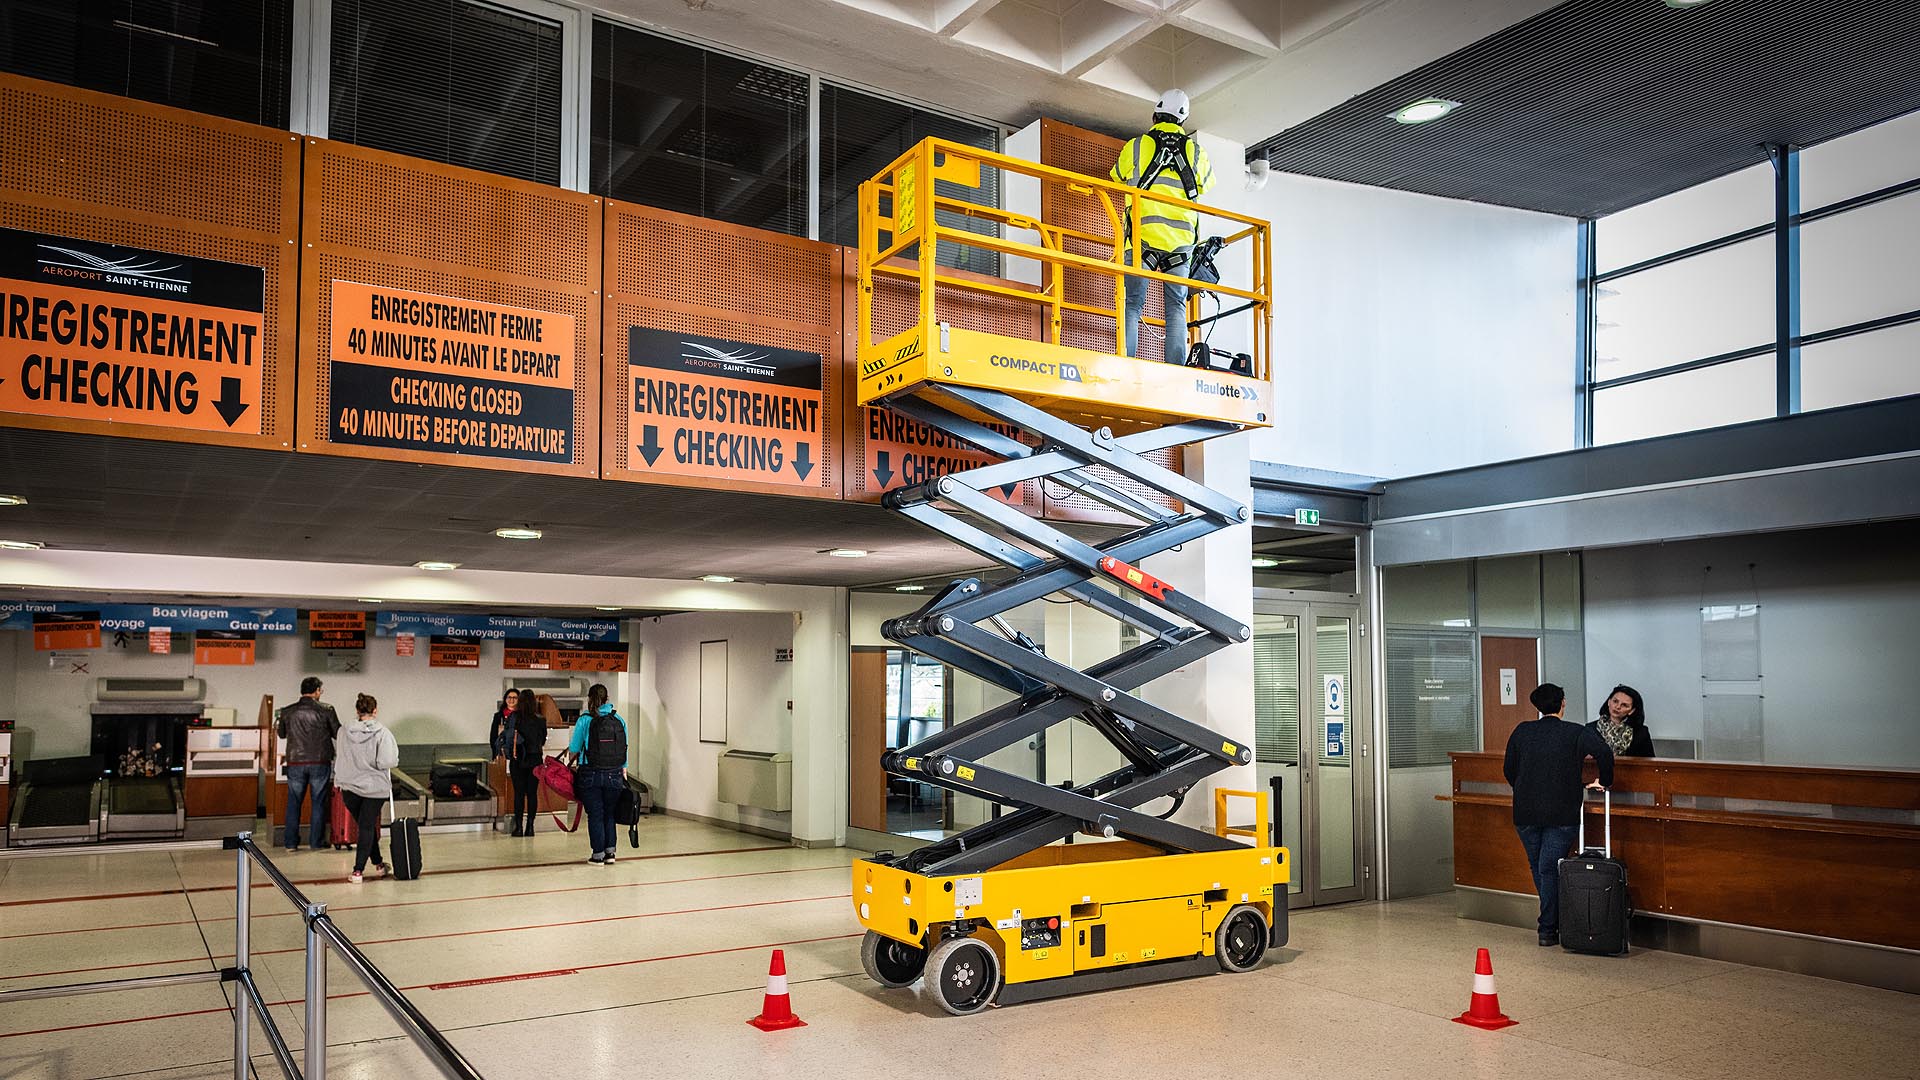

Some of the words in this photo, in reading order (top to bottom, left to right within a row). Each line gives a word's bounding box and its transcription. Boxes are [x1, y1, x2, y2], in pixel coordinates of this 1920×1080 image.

[43, 266, 103, 281] AEROPORT
[105, 274, 188, 293] SAINT-ETIENNE
[371, 294, 497, 336] ENREGISTREMENT
[500, 313, 543, 343] FERME
[0, 292, 257, 366] REGISTREMENT
[348, 328, 367, 355] 40
[371, 330, 437, 364] MINUTES
[441, 340, 489, 369] AVANT
[493, 346, 507, 372] LE
[511, 349, 561, 378] DEPART
[684, 358, 722, 369] AEROPORT
[722, 363, 775, 377] SAINT-ETIENNE
[990, 355, 1056, 375] COMPACT
[1061, 365, 1077, 379] 10
[21, 354, 199, 414] CHECKING
[1195, 379, 1240, 398] Haulotte
[390, 376, 466, 410] CHECKING
[470, 386, 523, 416] CLOSED
[634, 377, 818, 432] ENREGISTREMENT
[339, 407, 359, 435] 40
[362, 409, 430, 442] MINUTES
[433, 417, 487, 447] BEFORE
[490, 422, 565, 454] DEPARTURE
[673, 427, 783, 473] CHECKING
[0, 603, 23, 612] ood
[26, 604, 56, 613] travel
[152, 606, 177, 618] Boa
[180, 607, 229, 620] viagem
[100, 619, 145, 630] voyage
[229, 620, 260, 630] Gute
[262, 621, 293, 631] reise
[391, 613, 420, 623] Buono
[422, 615, 455, 625] viaggio
[488, 617, 517, 627] Sretan
[561, 621, 588, 630] Güvenli
[447, 627, 468, 636] Bon
[470, 629, 506, 639] voyage
[538, 630, 564, 639] Buen
[566, 630, 591, 641] viaje
